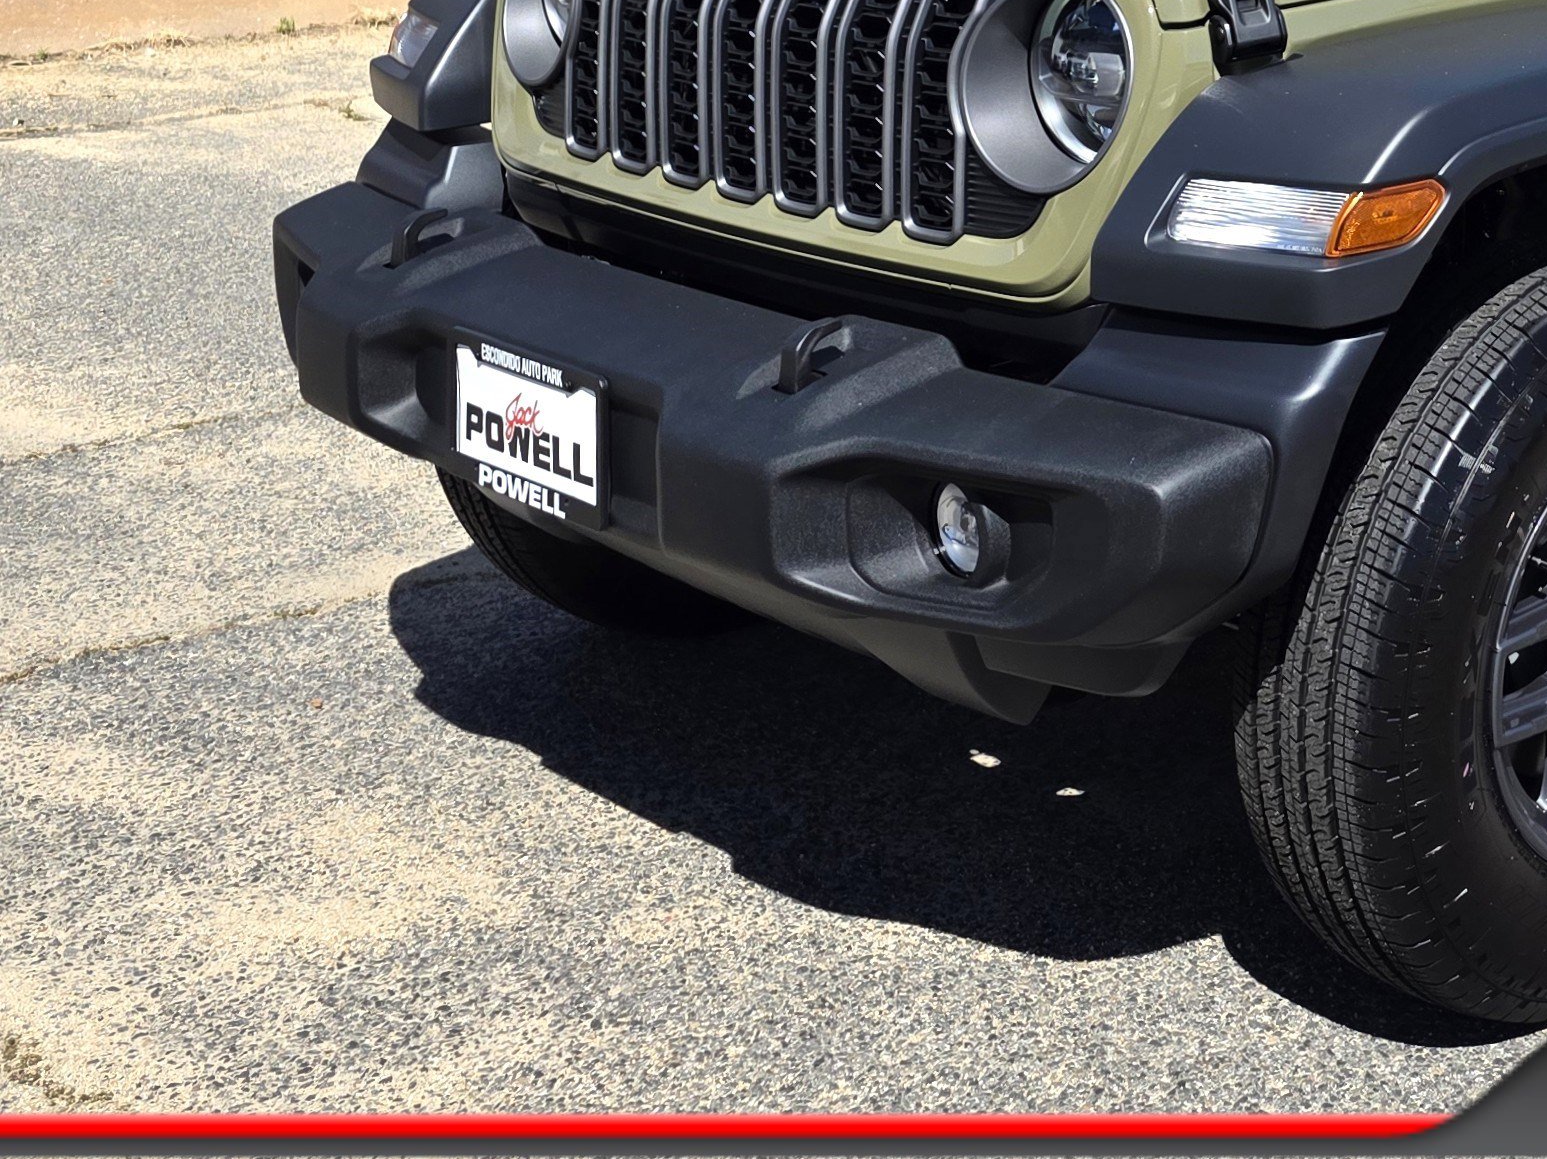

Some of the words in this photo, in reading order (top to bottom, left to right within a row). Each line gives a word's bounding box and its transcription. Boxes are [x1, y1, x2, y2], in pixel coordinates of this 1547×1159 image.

[481, 342, 521, 373] ESCONDIDO
[521, 357, 541, 381] AUTO
[541, 366, 563, 388] PARK
[504, 392, 544, 442] Jack
[465, 402, 595, 488] POWELL
[478, 462, 566, 520] POWELL
